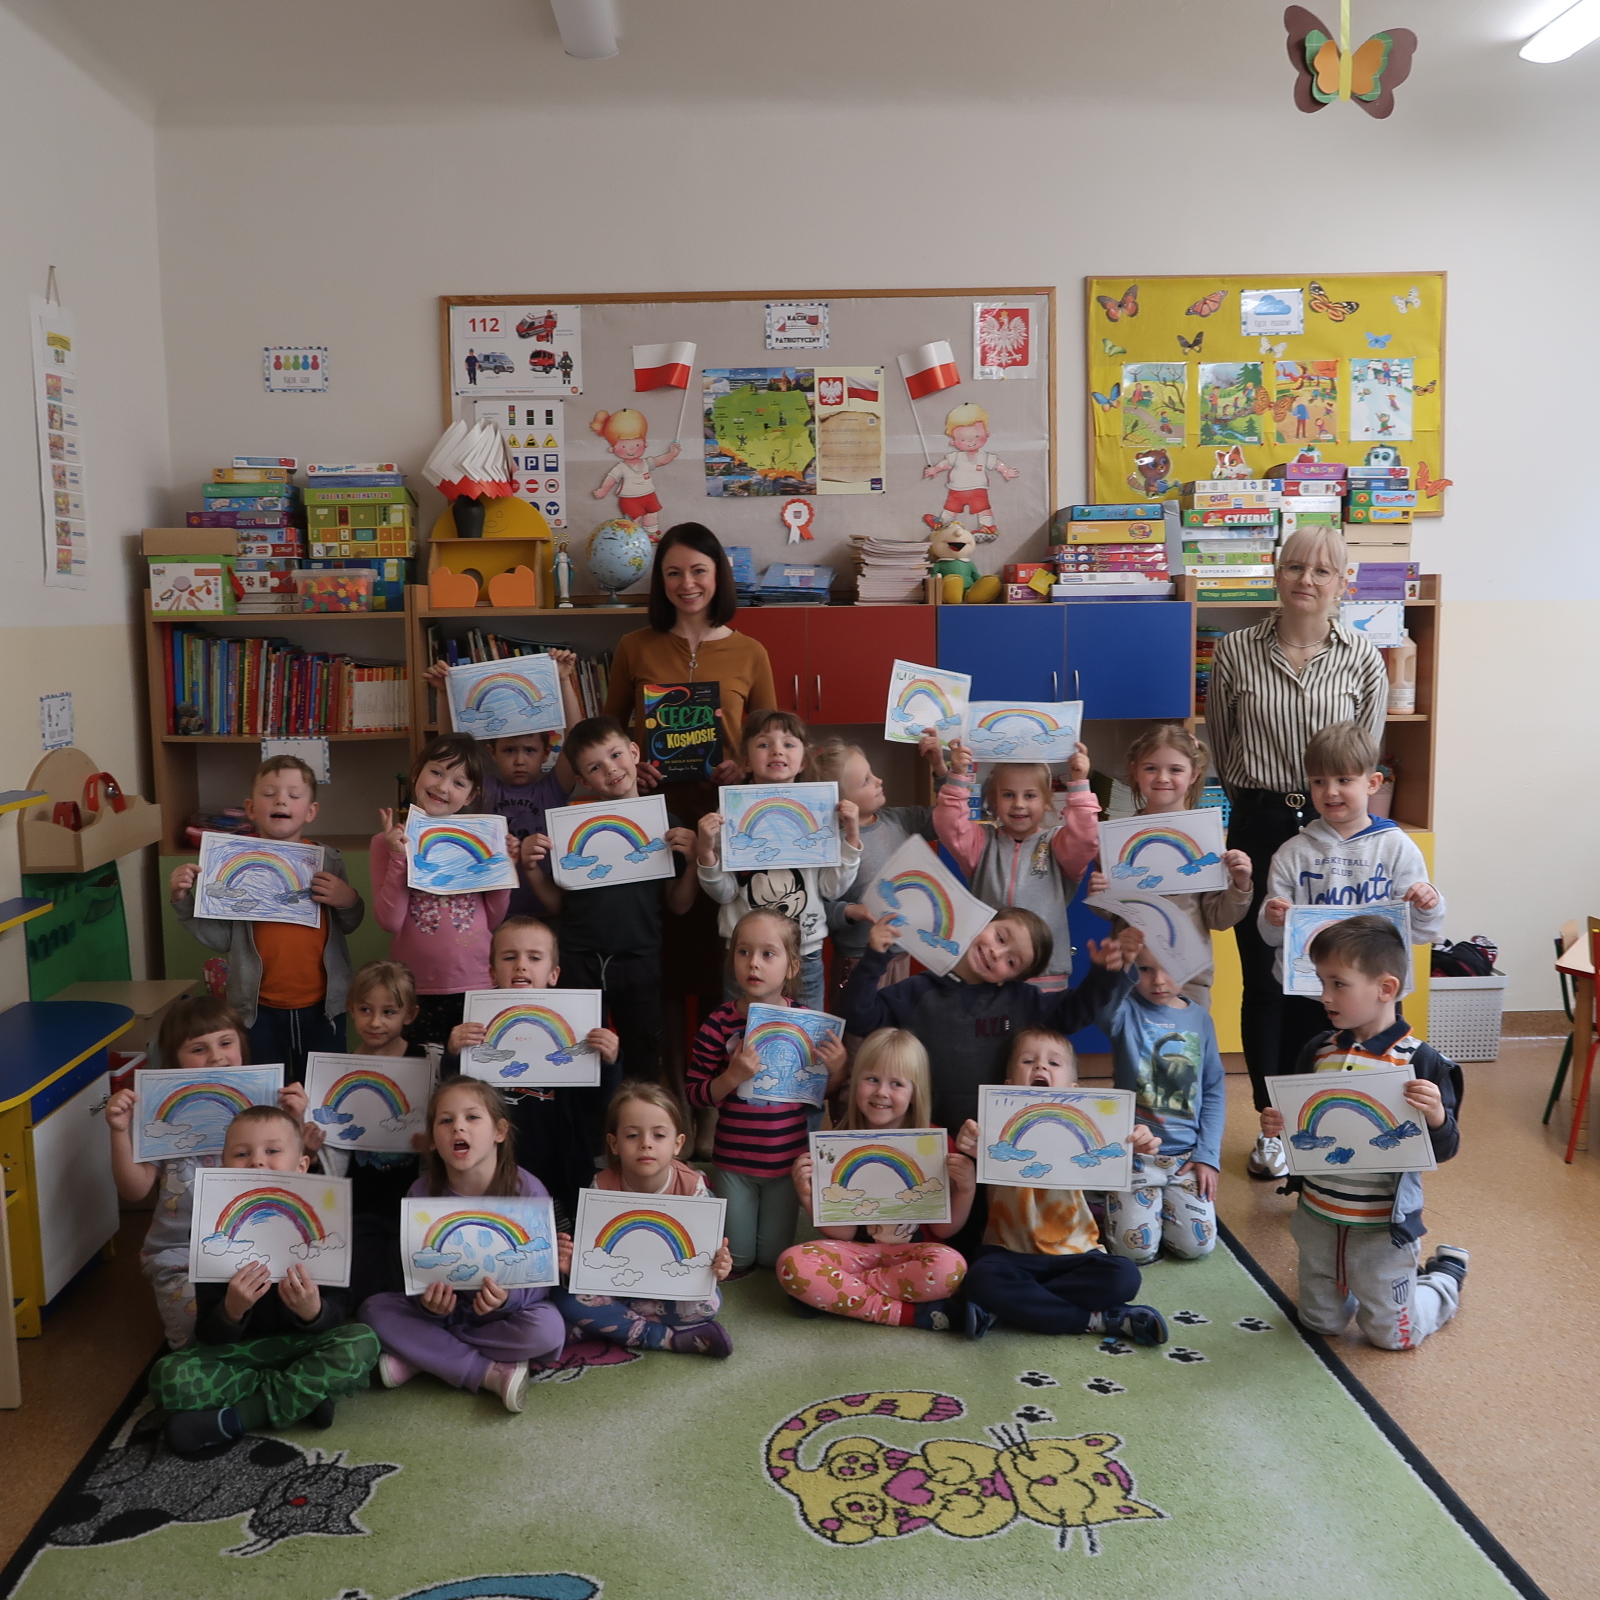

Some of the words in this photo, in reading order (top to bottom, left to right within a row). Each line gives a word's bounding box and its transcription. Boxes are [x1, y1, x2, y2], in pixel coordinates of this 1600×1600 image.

[468, 317, 500, 333] 112
[1209, 494, 1229, 503] QUIZ
[656, 705, 715, 731] TĘCZA
[666, 728, 717, 749] KOSMOSIE
[1314, 857, 1370, 867] BASKETBALL
[1331, 867, 1353, 877] CLUB
